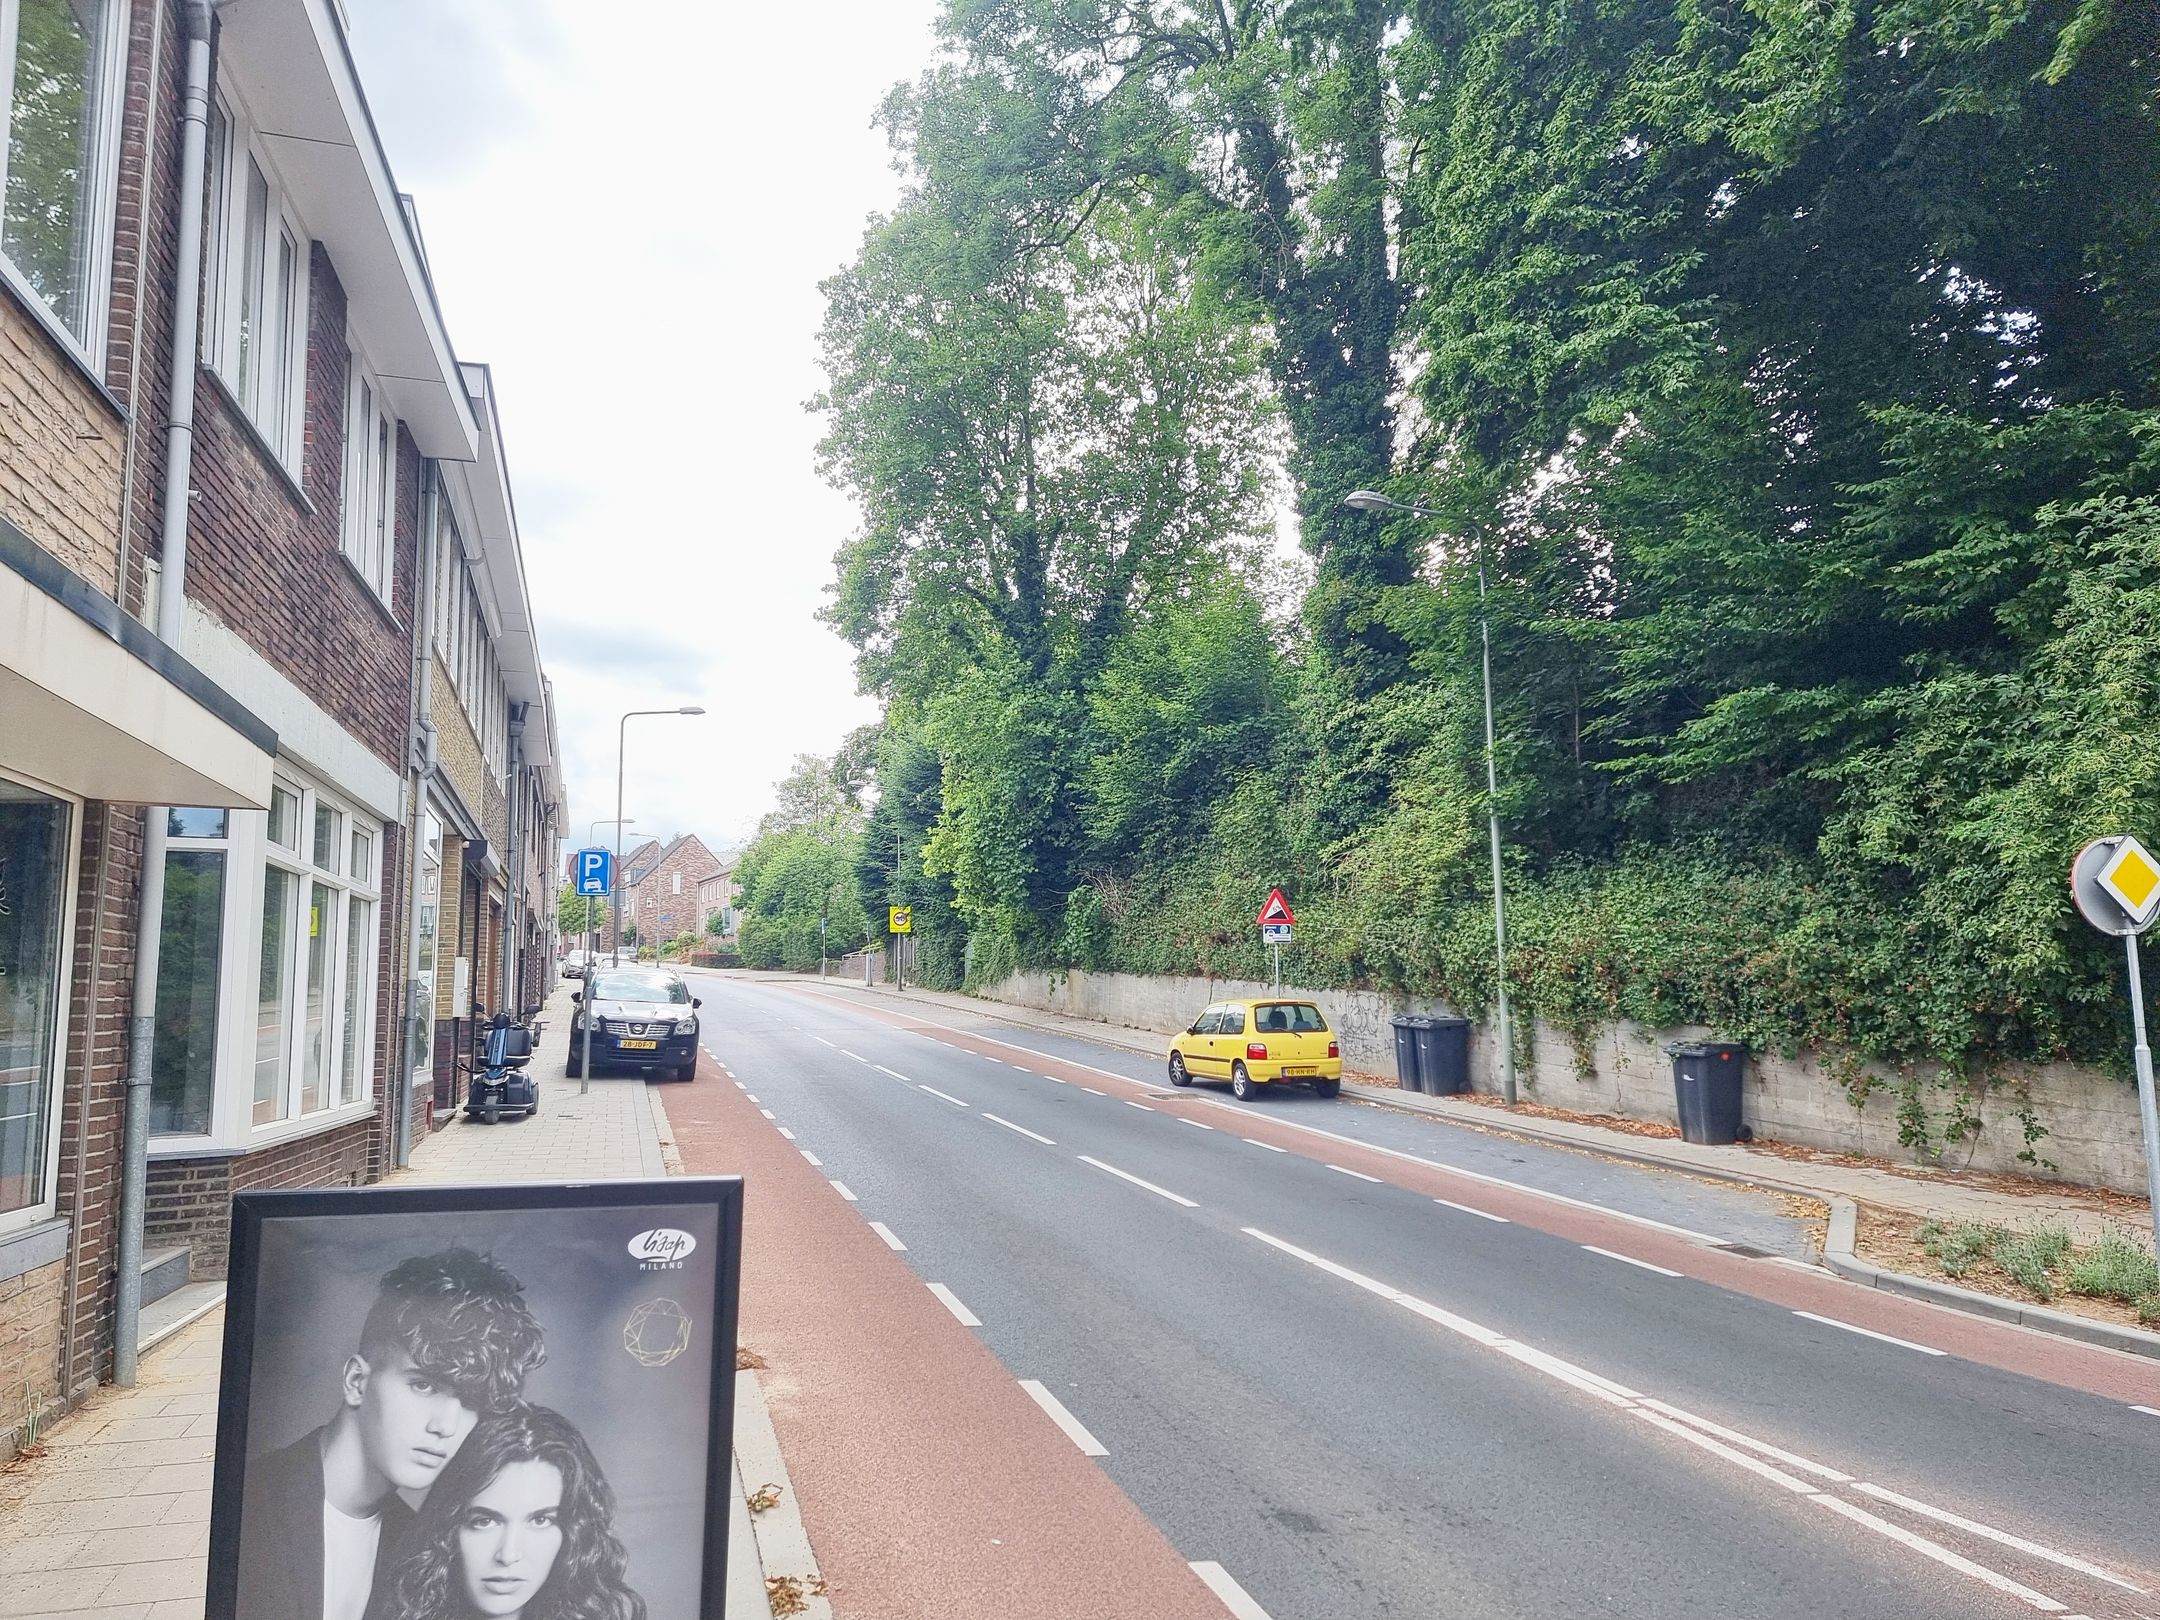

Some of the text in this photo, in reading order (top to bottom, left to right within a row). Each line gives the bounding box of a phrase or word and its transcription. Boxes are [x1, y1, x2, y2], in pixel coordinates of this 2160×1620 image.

[585, 853, 603, 877] P
[623, 1041, 654, 1049] 28-JDF-7
[639, 1262, 683, 1271] MILANO
